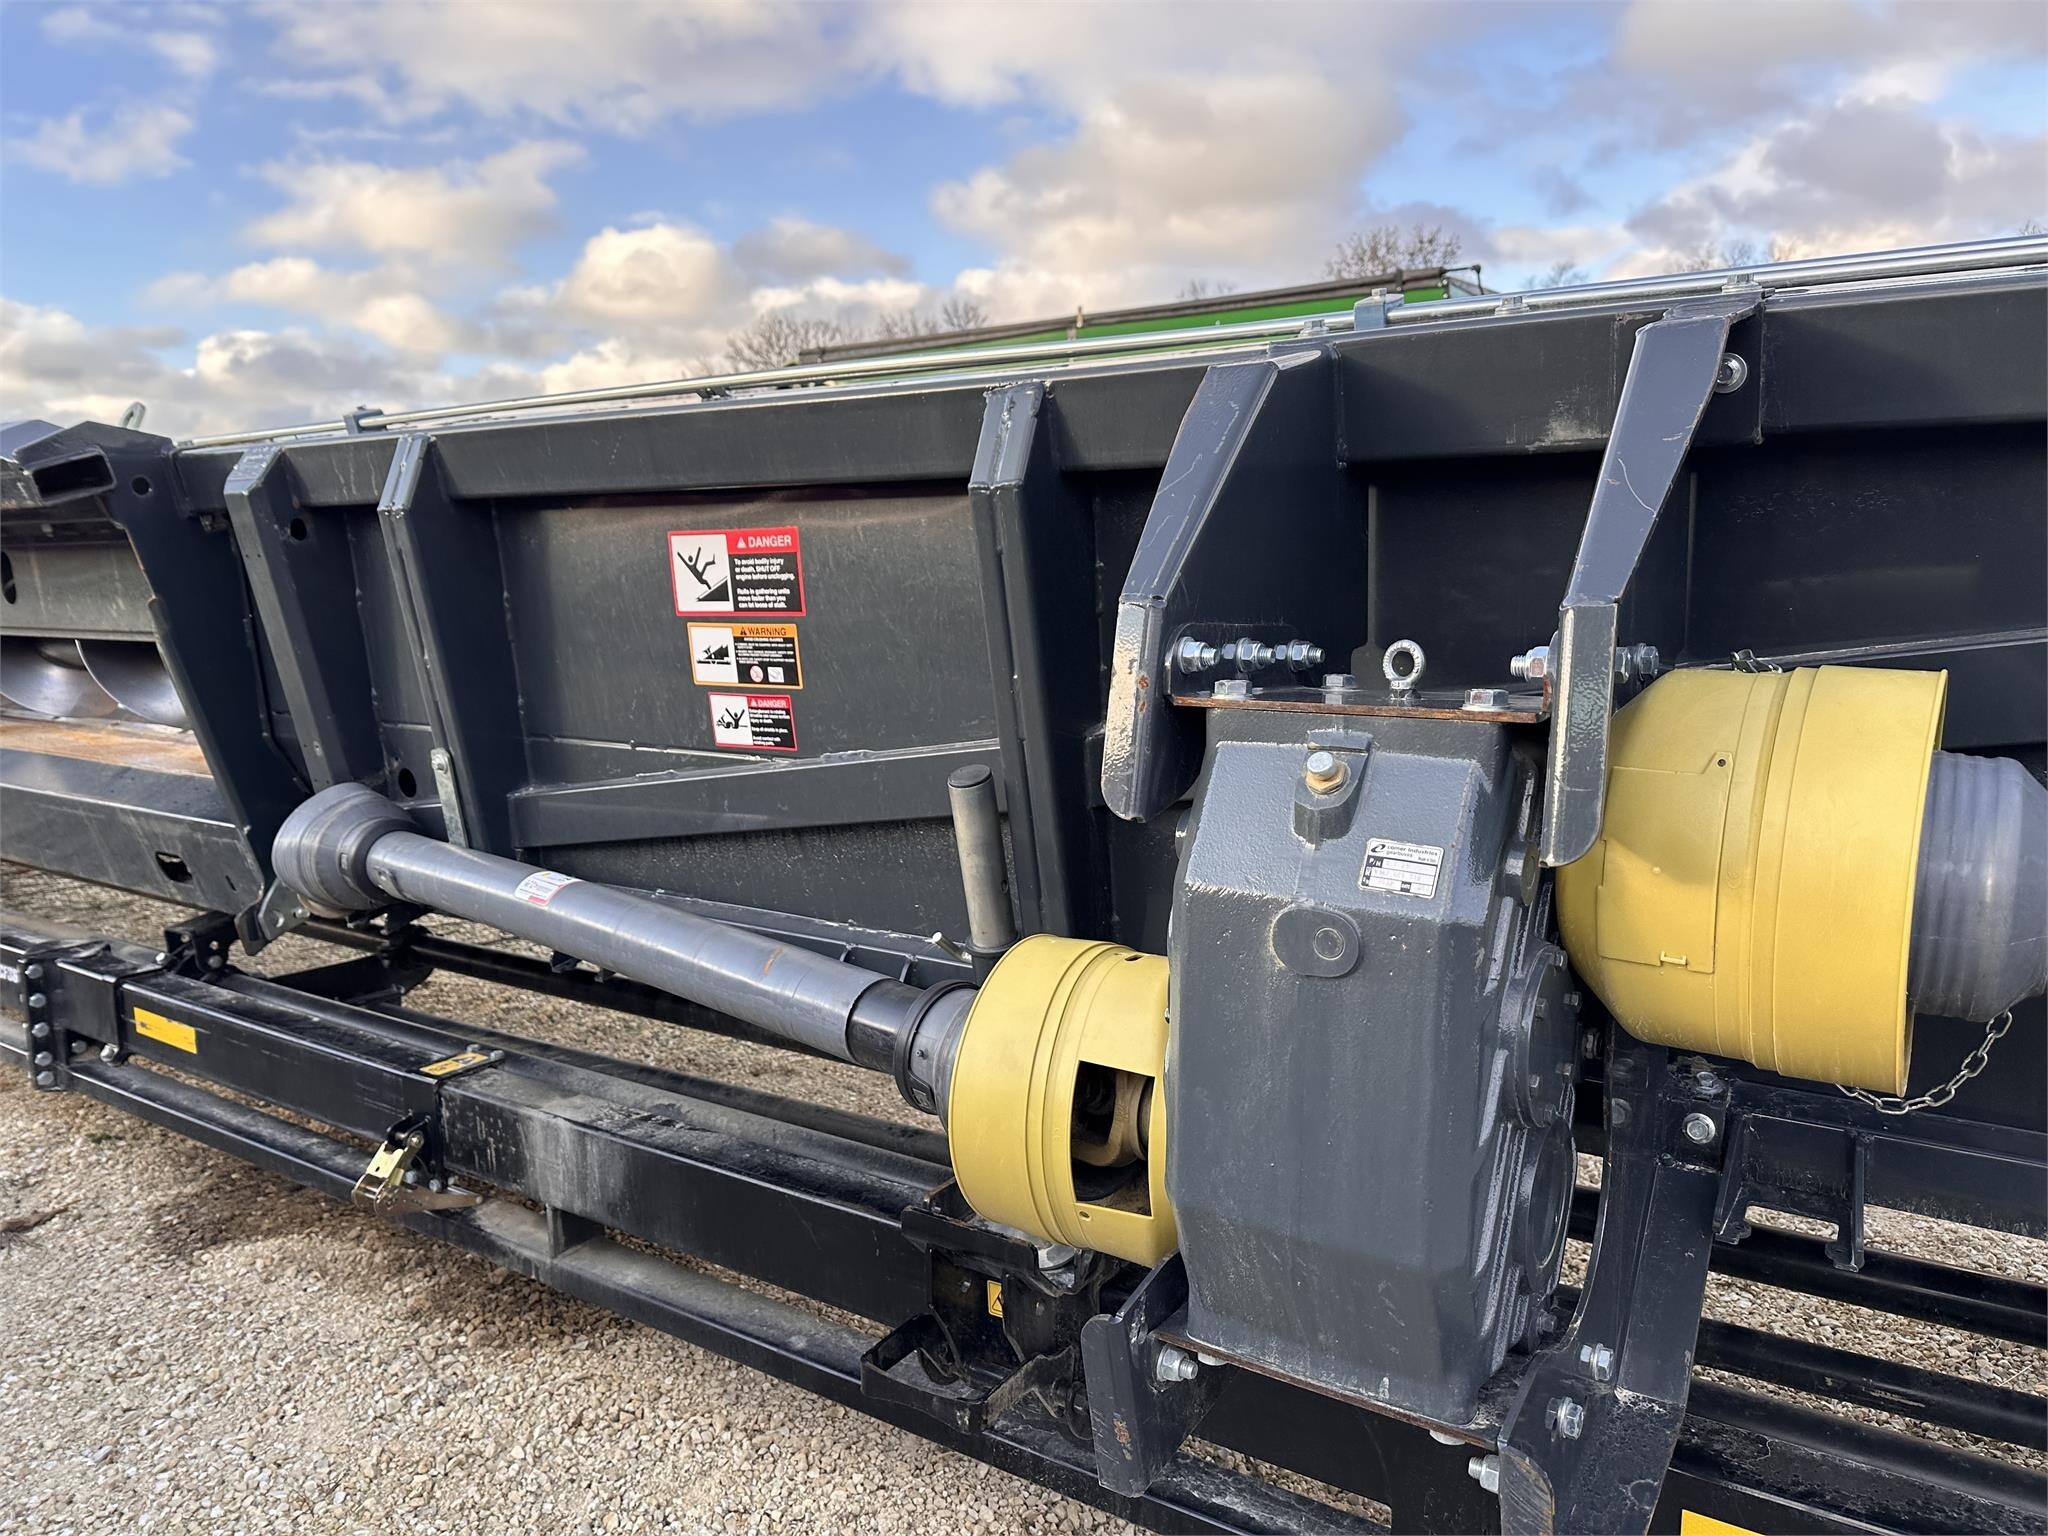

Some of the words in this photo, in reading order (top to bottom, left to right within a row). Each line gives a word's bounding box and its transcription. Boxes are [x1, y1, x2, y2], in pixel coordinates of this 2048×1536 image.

[748, 535, 792, 548] DANGER
[748, 628, 787, 636] WARNING
[758, 699, 786, 708] DANGER
[1408, 848, 1438, 856] industries
